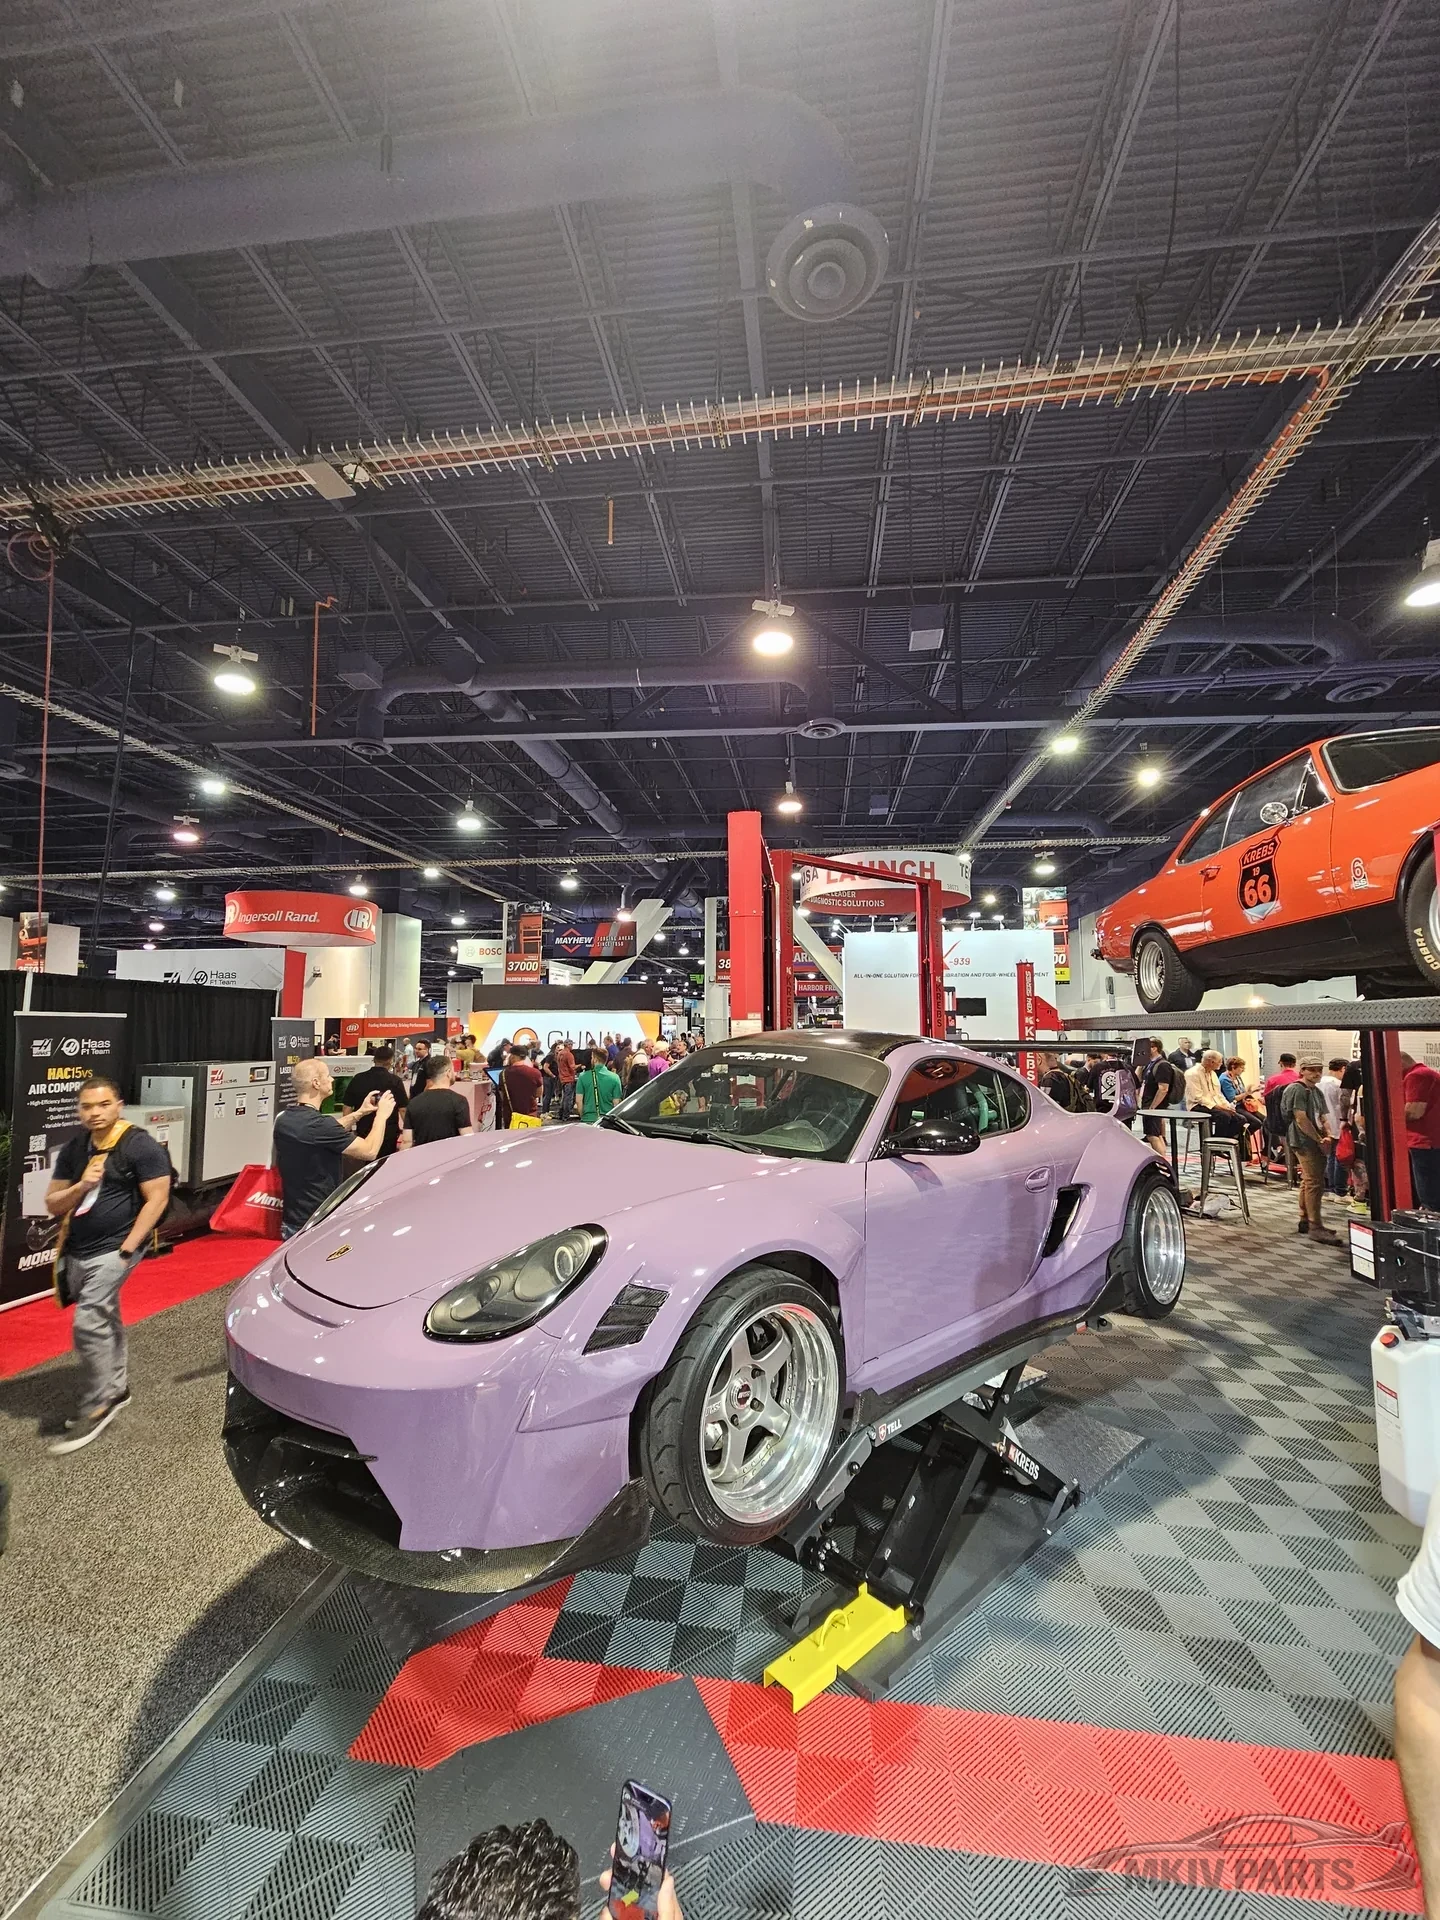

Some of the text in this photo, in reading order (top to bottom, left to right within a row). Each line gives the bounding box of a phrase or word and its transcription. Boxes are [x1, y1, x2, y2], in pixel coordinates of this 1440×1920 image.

[1243, 842, 1275, 865] KREBS
[1252, 866, 1261, 876] 19
[1243, 874, 1272, 908] 66
[842, 899, 886, 907] SOLUTIONS
[238, 911, 283, 925] Ingersoll
[350, 909, 370, 929] IR
[555, 936, 594, 945] MAYHEW
[507, 961, 539, 972] 37000
[210, 970, 237, 979] Haas
[935, 984, 943, 1028] KREBS
[81, 1038, 111, 1048] Haas
[1025, 1026, 1036, 1081] KEBS
[47, 1066, 93, 1081] HAC15vs
[28, 1084, 47, 1095] AIR
[18, 1248, 58, 1270] MORE
[886, 1418, 903, 1435] TELL
